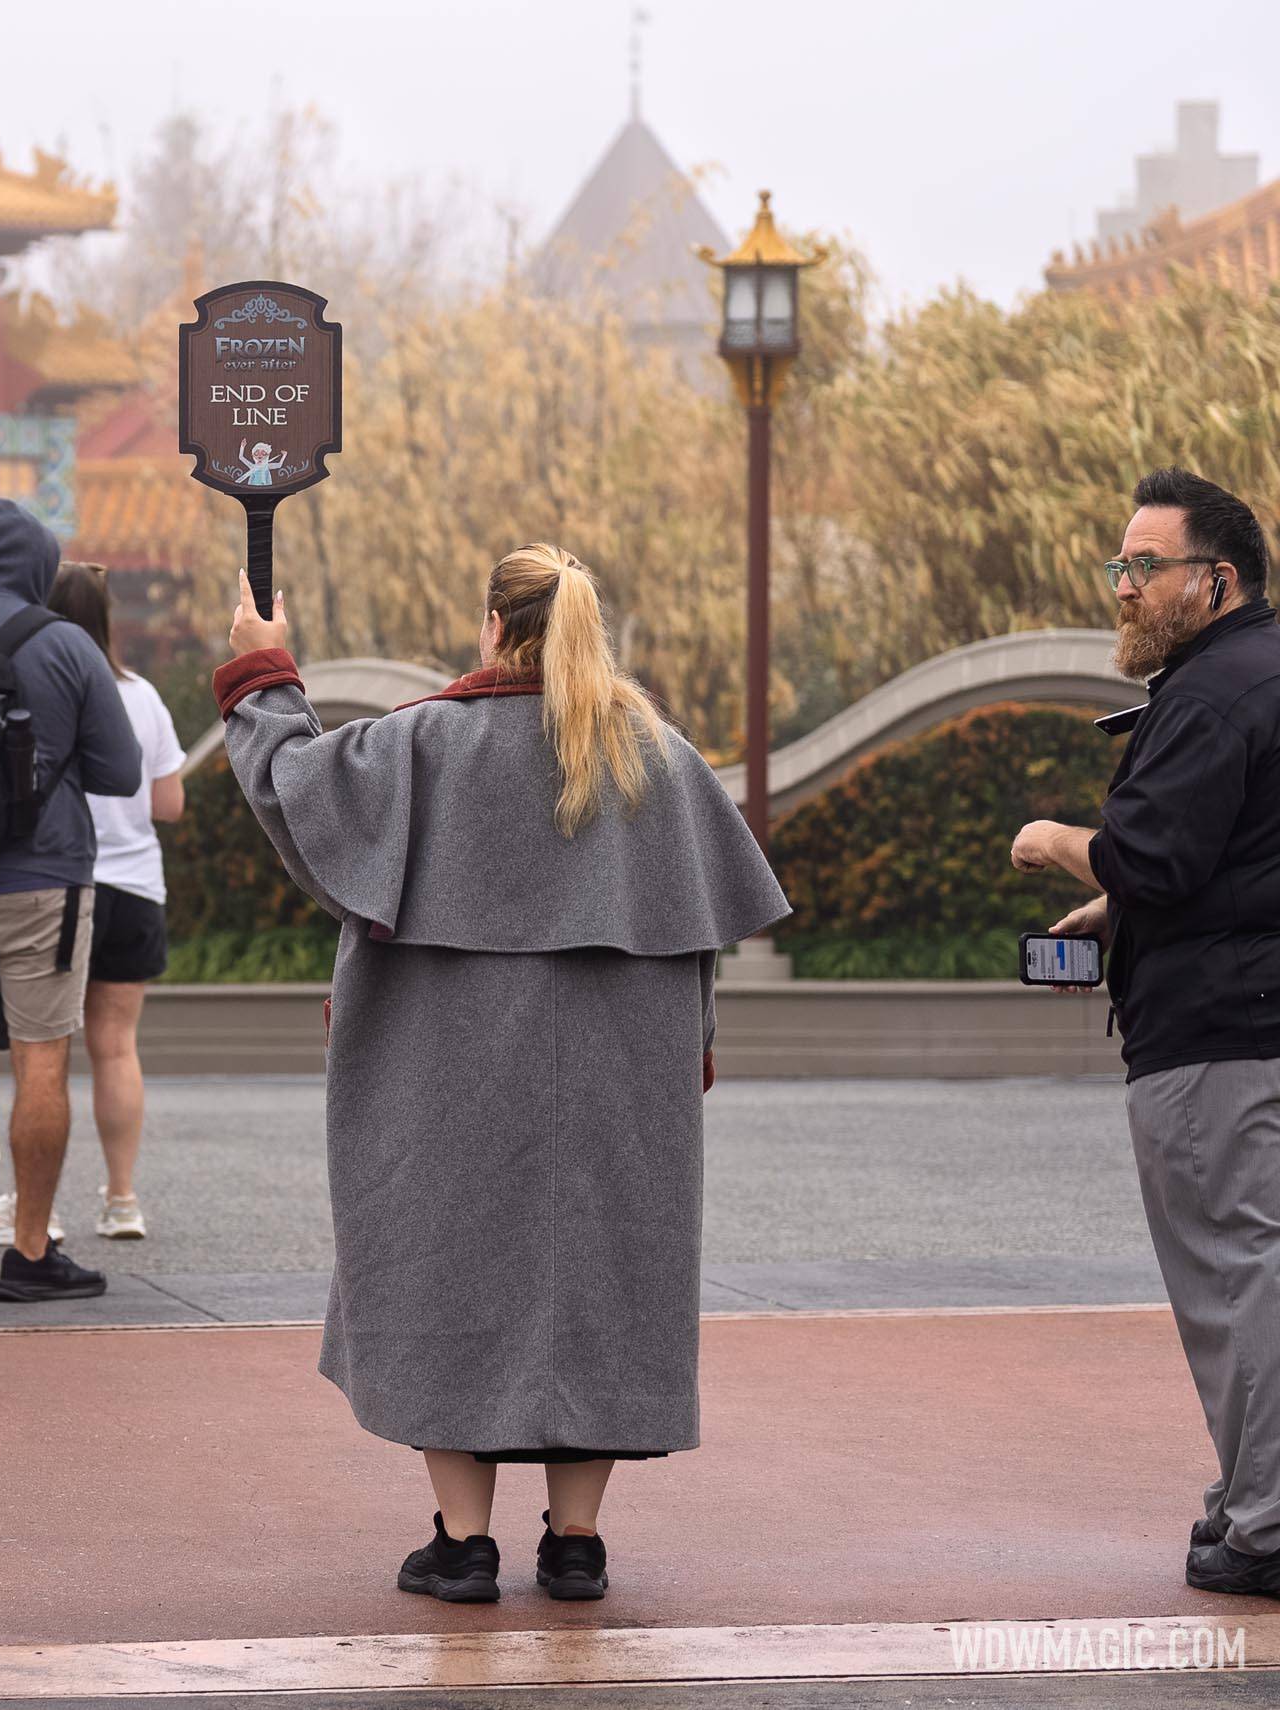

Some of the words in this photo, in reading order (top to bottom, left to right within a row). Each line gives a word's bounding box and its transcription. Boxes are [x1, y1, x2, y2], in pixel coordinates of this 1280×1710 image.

[215, 336, 305, 361] FROZEN
[223, 361, 255, 370] ever
[261, 358, 297, 370] after
[210, 385, 266, 402] END
[275, 384, 310, 402] OF
[232, 407, 288, 425] LINE
